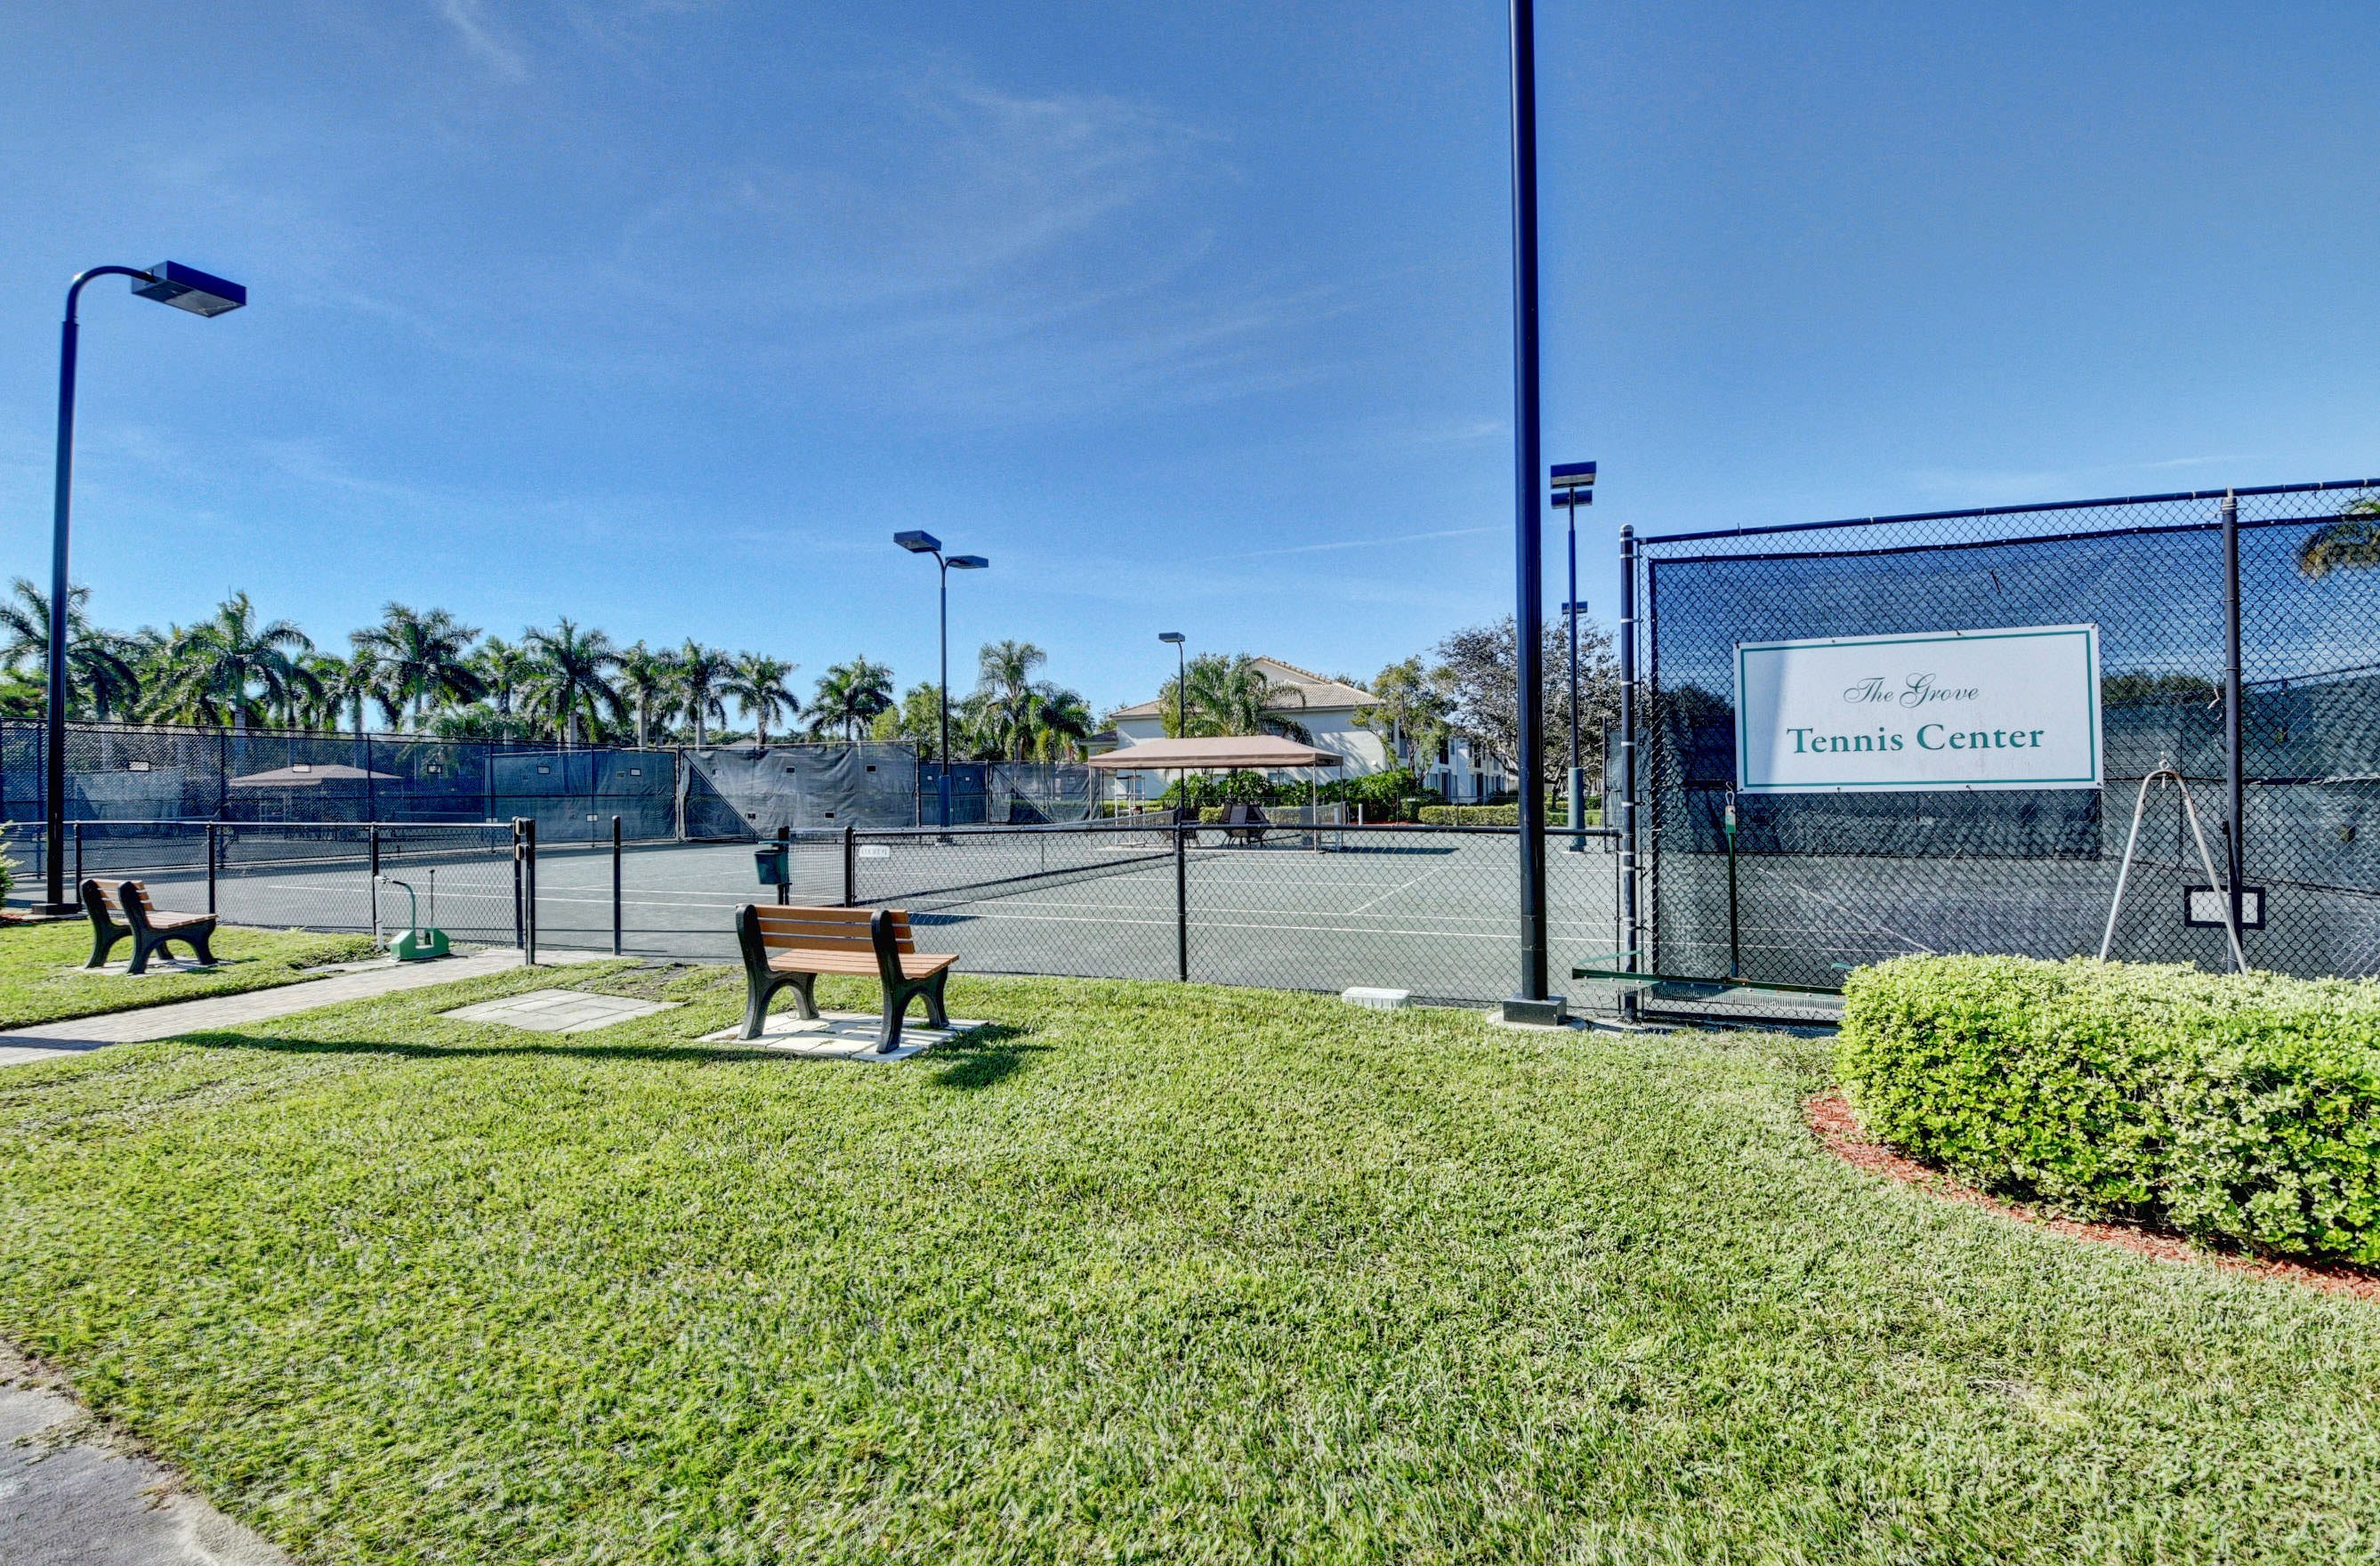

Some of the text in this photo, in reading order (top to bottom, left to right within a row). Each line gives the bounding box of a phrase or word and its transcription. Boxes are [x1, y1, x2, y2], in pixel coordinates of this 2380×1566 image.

[1843, 672, 1980, 709] The Grove
[1786, 723, 2045, 754] Tennis Center
